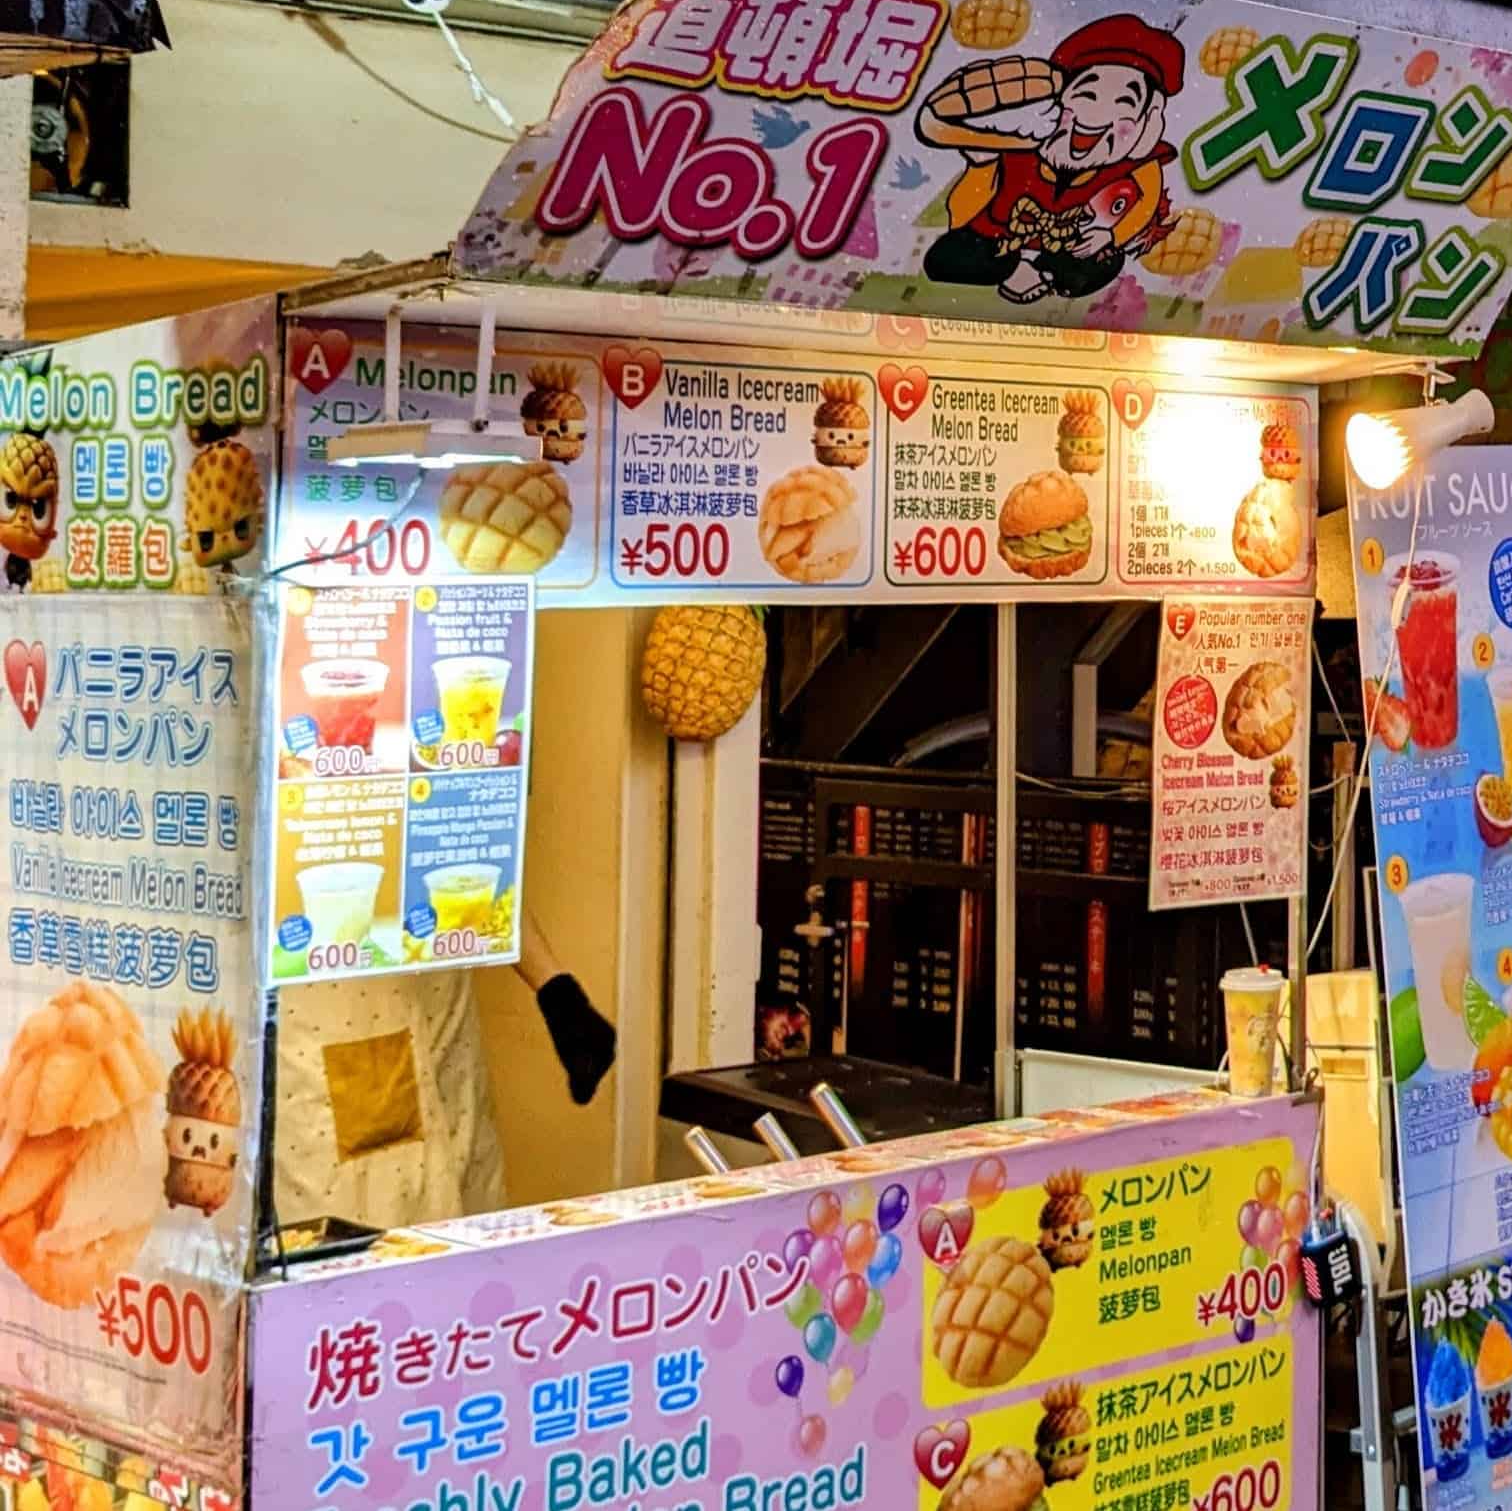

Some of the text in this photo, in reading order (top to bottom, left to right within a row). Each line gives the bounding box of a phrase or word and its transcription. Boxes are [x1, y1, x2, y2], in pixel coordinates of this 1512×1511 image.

[540, 93, 890, 259] No.1
[1306, 217, 1506, 335] パン
[301, 343, 331, 380] A
[355, 356, 518, 397] Melonpn
[622, 364, 645, 397] B
[0, 359, 266, 425] Melon Bread
[665, 369, 820, 405] Vanilla Icecream
[892, 380, 916, 409] C
[932, 386, 1060, 416] Greentea Icecream
[1125, 392, 1144, 422] D
[664, 400, 787, 434] Melon Bread
[932, 413, 1018, 442] Melon Bread
[74, 443, 170, 499] 멜론 빵
[623, 434, 761, 461] バニラアイスメロンパン
[894, 443, 998, 468] 抹茶アイスメロンパン
[623, 463, 666, 486] 바닐라
[670, 464, 709, 486] 아이스
[922, 470, 956, 492] 아이스
[304, 518, 432, 577] ¥400
[620, 523, 731, 577] ¥500
[893, 526, 987, 577] ¥600
[1127, 558, 1173, 577] 2pieces
[1199, 609, 1306, 628] Popular number one
[23, 665, 40, 713] A
[55, 644, 239, 705] バニラアイス
[57, 709, 213, 766] メロンパン
[153, 792, 211, 846] 멜론
[131, 858, 186, 911] Melon
[1100, 1162, 1212, 1214] メロンパン
[935, 1217, 959, 1256] A
[1099, 1216, 1158, 1251] 멜론 빵
[1099, 1246, 1193, 1283] Melonpan
[1328, 1249, 1354, 1297] JBL
[1197, 1262, 1288, 1327] ¥400
[1421, 1268, 1496, 1328] かき氷
[96, 1277, 212, 1375] ¥500
[308, 1252, 811, 1411] 焼きたてメロンパン
[1096, 1349, 1287, 1429] 抹茶アイスメロンパン
[310, 1424, 371, 1496] 갓
[398, 1392, 507, 1477] 구운
[531, 1363, 632, 1445] 멜론
[655, 1349, 706, 1414] 빵
[1133, 1420, 1180, 1451] 아이스
[547, 1421, 712, 1509] Baked
[930, 1439, 956, 1477] C
